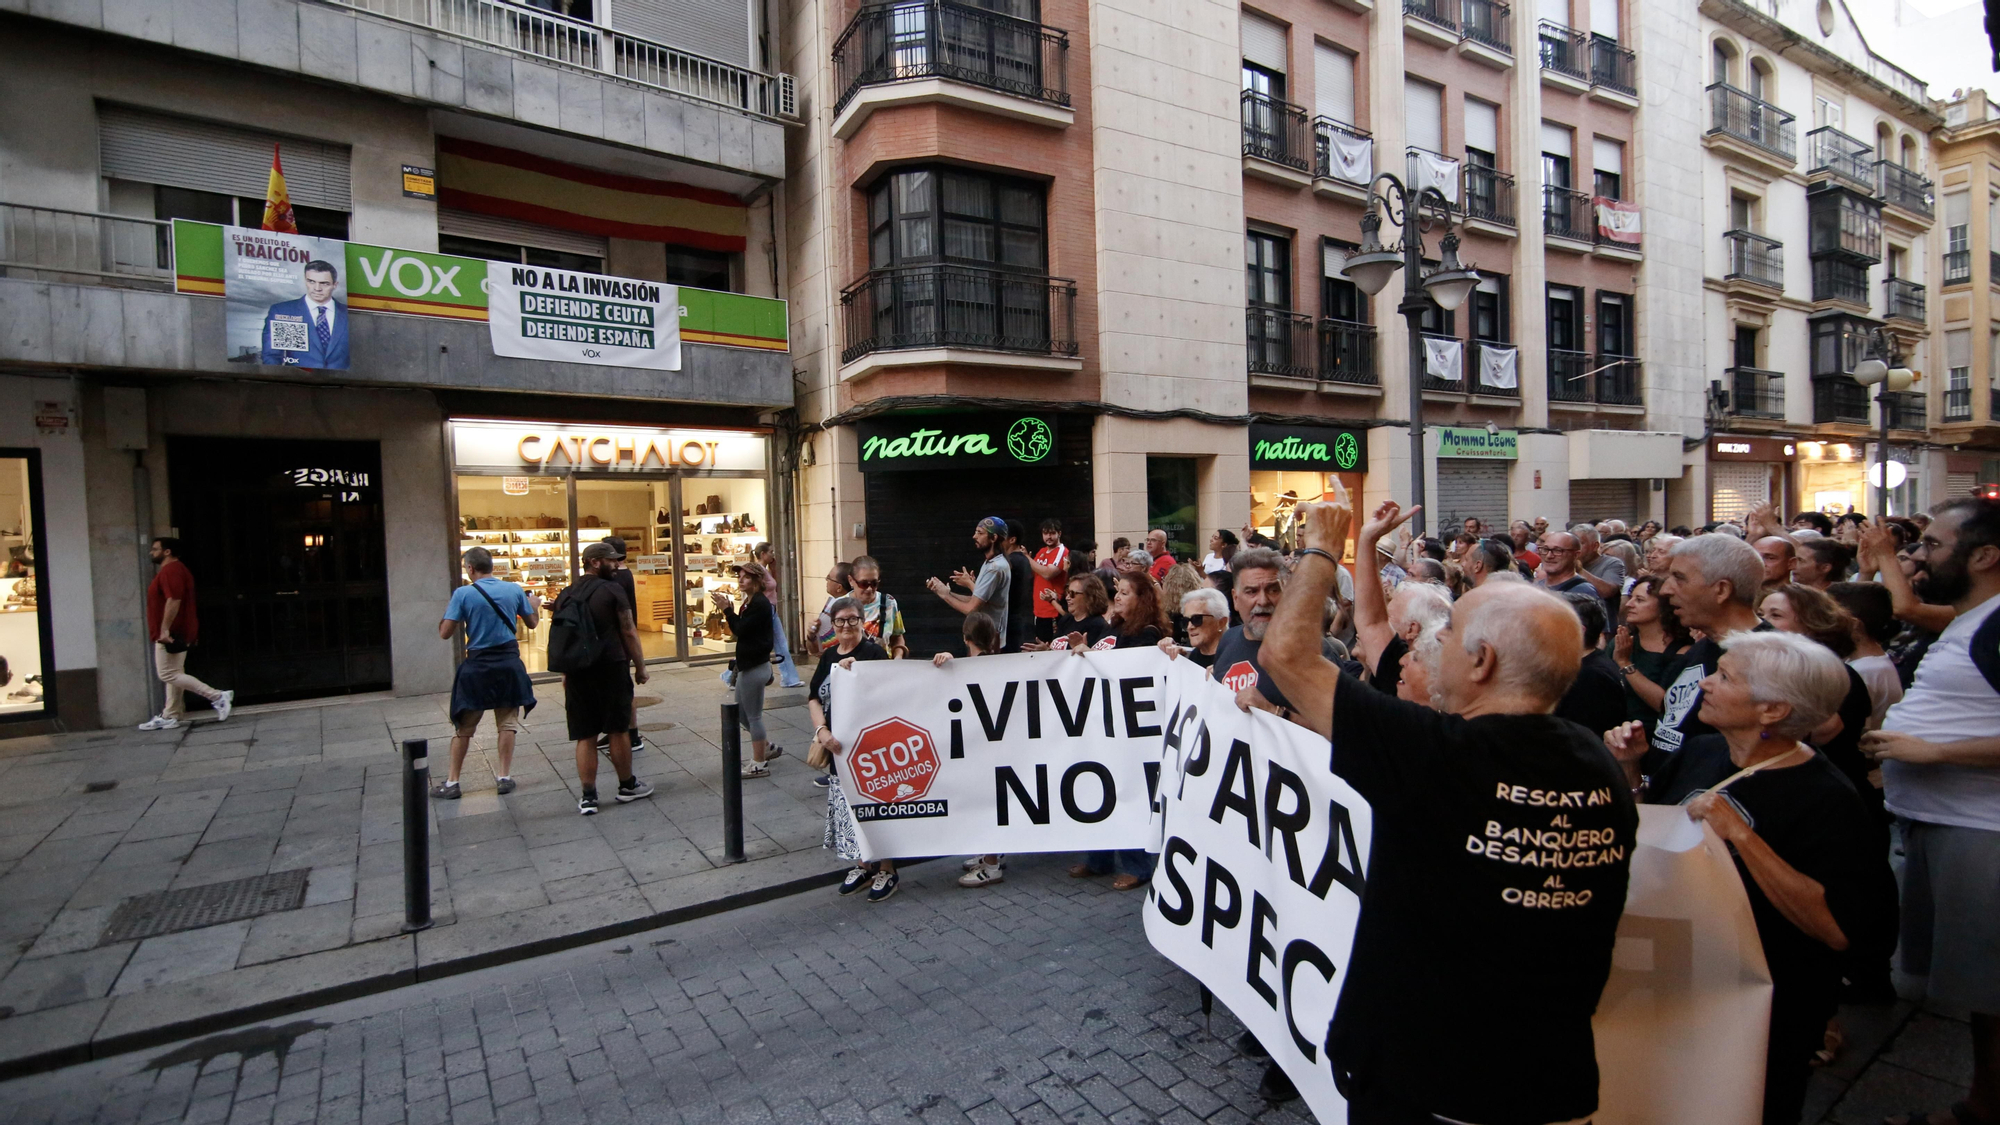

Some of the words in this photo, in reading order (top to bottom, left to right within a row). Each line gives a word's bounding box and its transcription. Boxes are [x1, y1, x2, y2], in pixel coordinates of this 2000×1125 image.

[235, 241, 311, 264] TRAICIÓN
[243, 235, 253, 243] UN
[254, 237, 280, 246] DELITO
[281, 240, 290, 248] DE
[359, 250, 462, 297] VOX
[512, 267, 538, 288] NO
[542, 272, 555, 290] A
[558, 273, 580, 293] LA
[583, 276, 660, 304] INVASIÓN
[524, 294, 600, 319] DEFIENDE
[604, 306, 650, 325] CEUTA
[526, 321, 595, 343] DEFIENDE
[598, 328, 651, 348] ESPAÑA
[582, 348, 601, 358] VOX
[517, 433, 719, 466] CATCHALOT
[863, 428, 998, 461] natura
[1255, 436, 1331, 461] natura
[1443, 429, 1485, 447] Mamma
[1487, 431, 1517, 448] Leone
[1224, 672, 1256, 691] STOP
[948, 675, 1167, 760] ¡VIVIE
[857, 734, 924, 778] STOP
[866, 760, 934, 793] DESAHUCIOS
[995, 760, 1117, 827] NO
[879, 802, 945, 816] CÓRDOBA
[1550, 814, 1572, 828] AL
[1485, 820, 1615, 851] BANQUERO
[1466, 834, 1624, 869] DESAHUCIAN
[1543, 874, 1565, 889] AL
[1501, 887, 1593, 909] OBRERO
